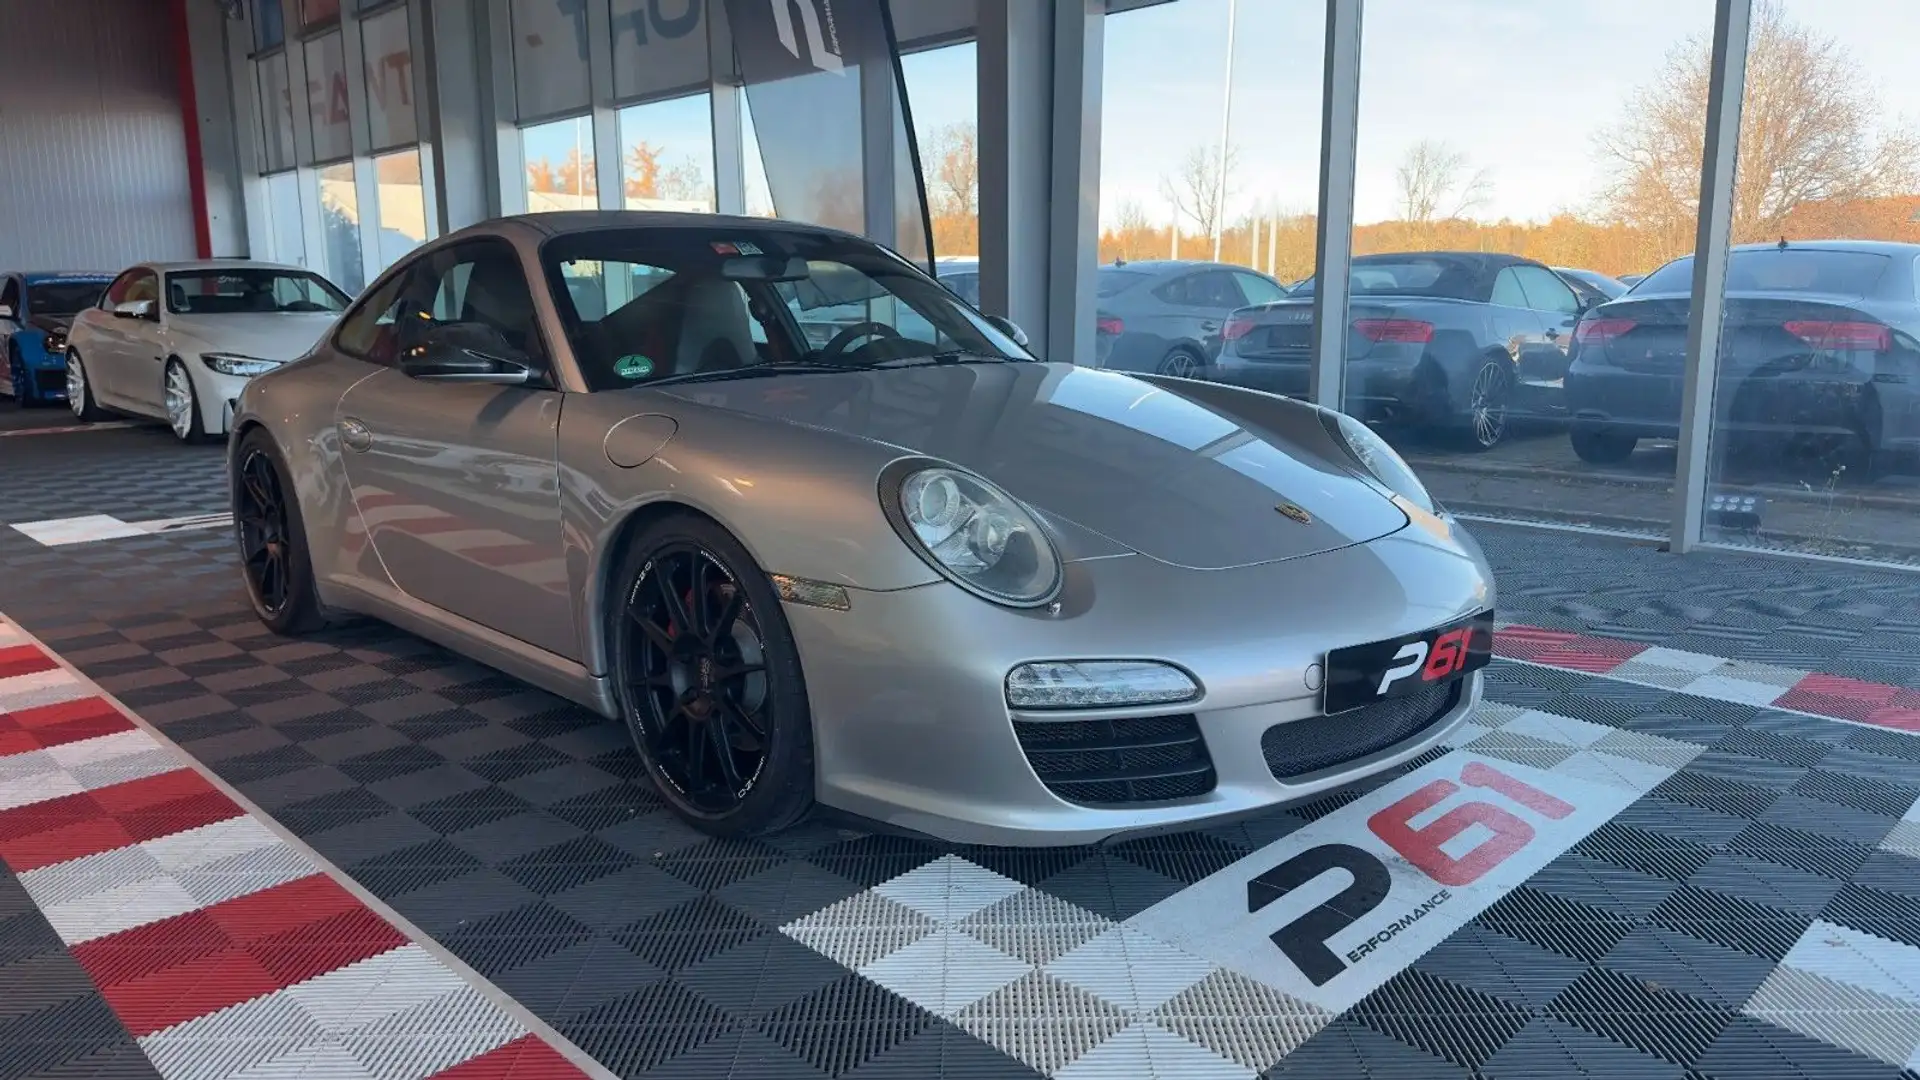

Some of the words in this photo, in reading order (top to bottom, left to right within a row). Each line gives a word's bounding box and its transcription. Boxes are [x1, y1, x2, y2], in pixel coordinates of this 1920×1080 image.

[1376, 626, 1474, 695] P61
[1247, 761, 1576, 988] P61
[1346, 889, 1453, 963] ERFORMANCE
